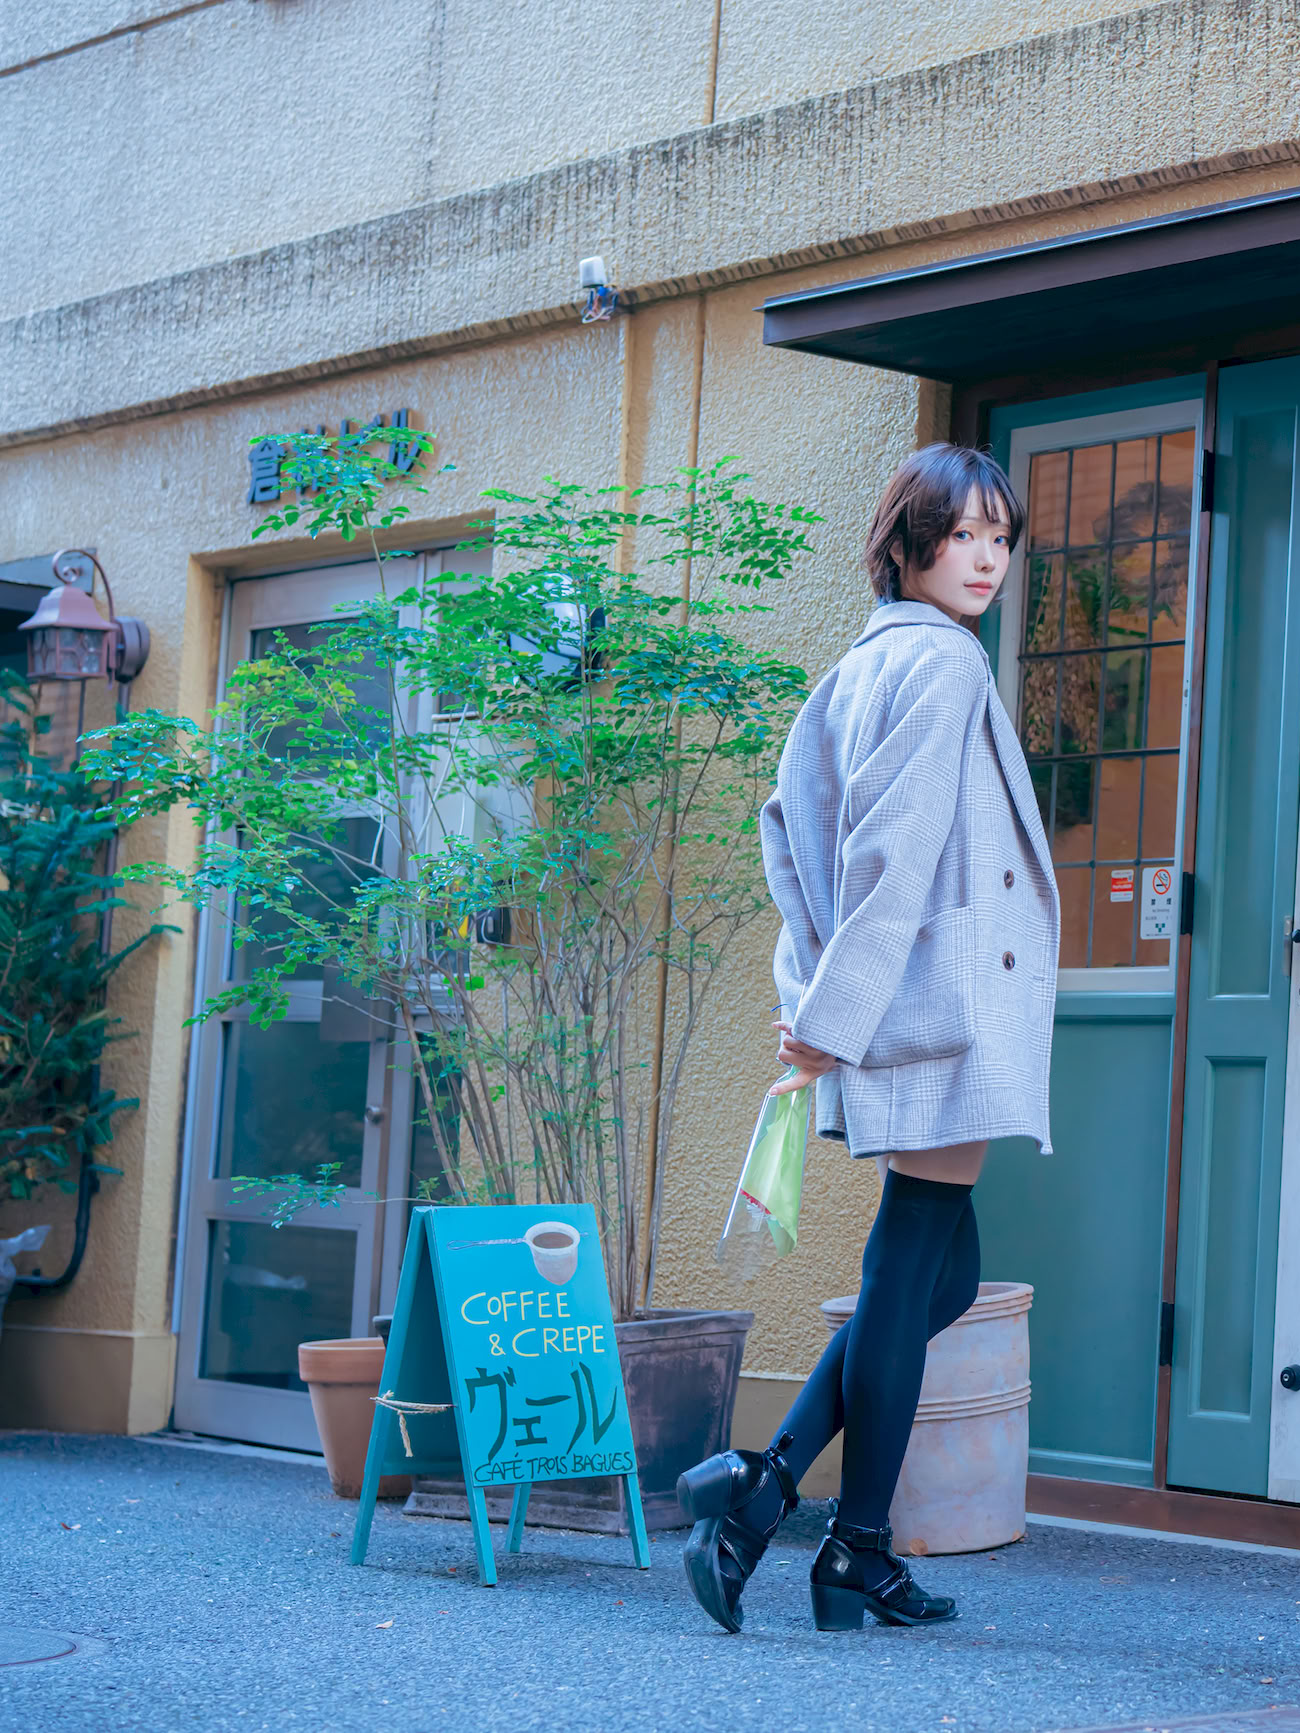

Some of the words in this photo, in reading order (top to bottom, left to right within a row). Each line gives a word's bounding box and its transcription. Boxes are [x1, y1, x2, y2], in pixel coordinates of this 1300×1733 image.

[460, 1290, 571, 1325] COFFEE
[488, 1333, 506, 1356] &
[511, 1325, 605, 1357] CREPE
[464, 1361, 618, 1463] ヴェール
[474, 1452, 525, 1483] CAFÉ
[527, 1456, 567, 1480] TROIS
[571, 1451, 633, 1473] BAGUES
